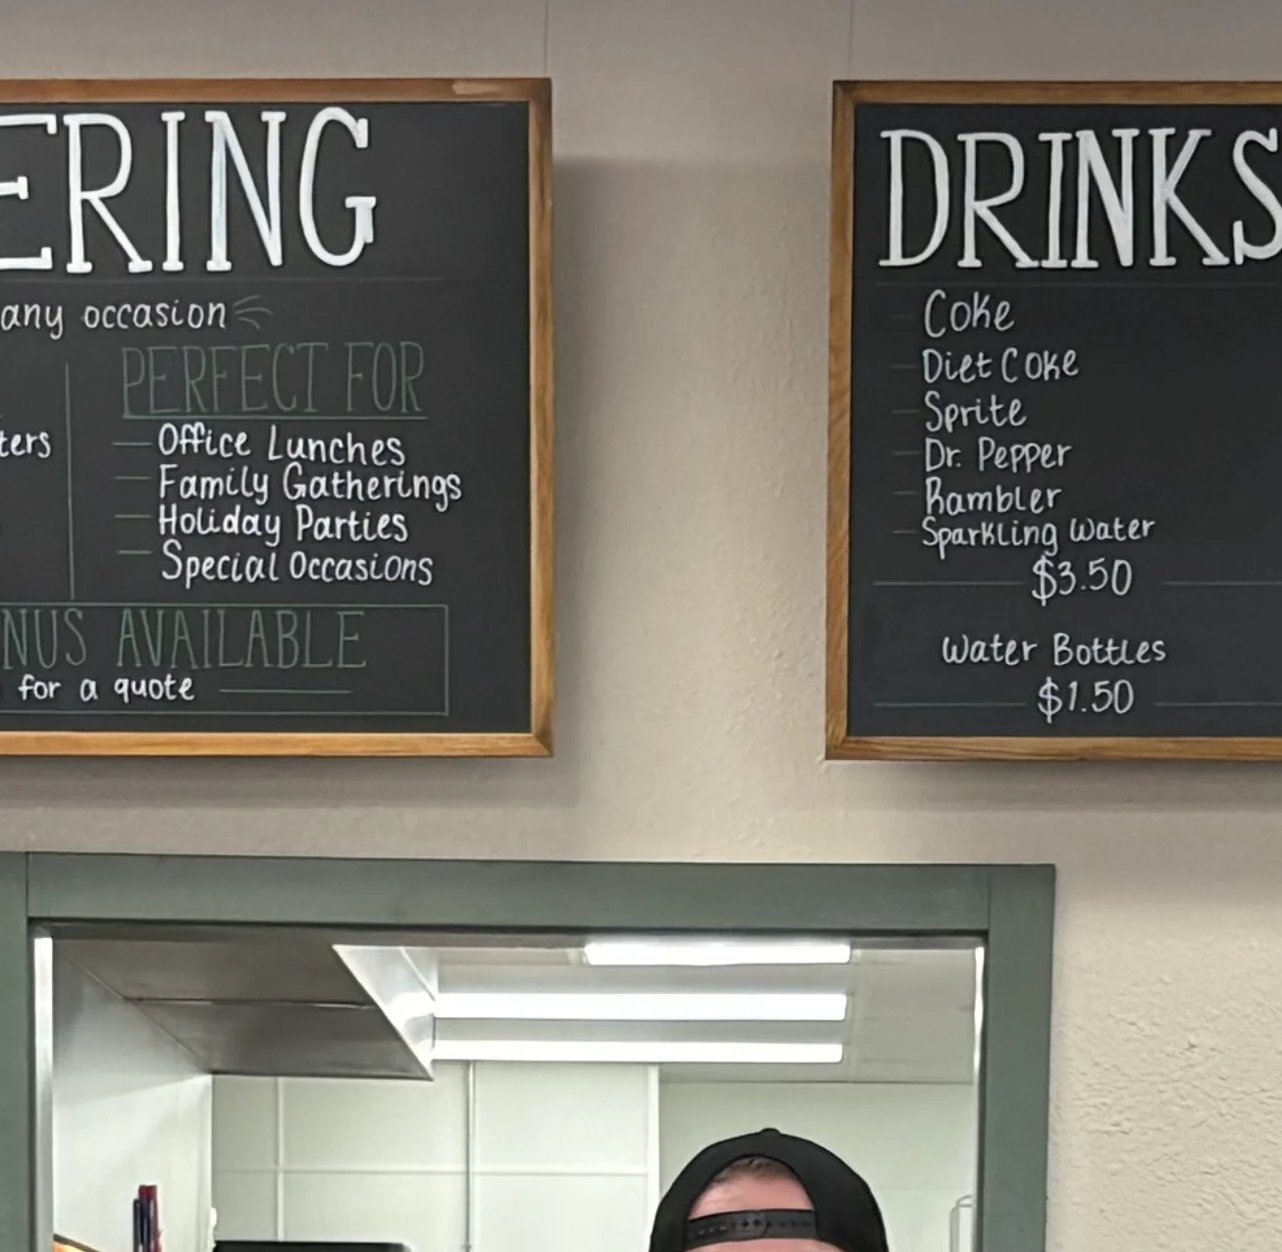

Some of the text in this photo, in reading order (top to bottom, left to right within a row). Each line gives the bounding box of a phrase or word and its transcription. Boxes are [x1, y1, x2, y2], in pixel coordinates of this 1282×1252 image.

[1, 304, 63, 339] any
[84, 303, 225, 328] occasion
[925, 289, 1014, 337] Coke
[121, 341, 423, 415] PERFECT FOR
[923, 348, 1078, 383] Diet Coke
[924, 390, 1027, 432] Sprite
[159, 422, 405, 468] Office Lunches
[926, 436, 1071, 473] Dr. Pepper
[159, 464, 462, 513] Family Gatherings
[925, 477, 1063, 516] Rambler
[159, 510, 408, 546] Holiday Parties
[922, 516, 1058, 558] Sparkling
[162, 541, 433, 588] Special Occasions
[1031, 554, 1133, 606] $3.50
[117, 610, 369, 669] AVAILABLE
[1054, 633, 1166, 665] Bottles
[18, 674, 61, 700] for
[80, 679, 97, 701] a
[114, 674, 194, 703] quote
[1038, 678, 1133, 723] $1.50
